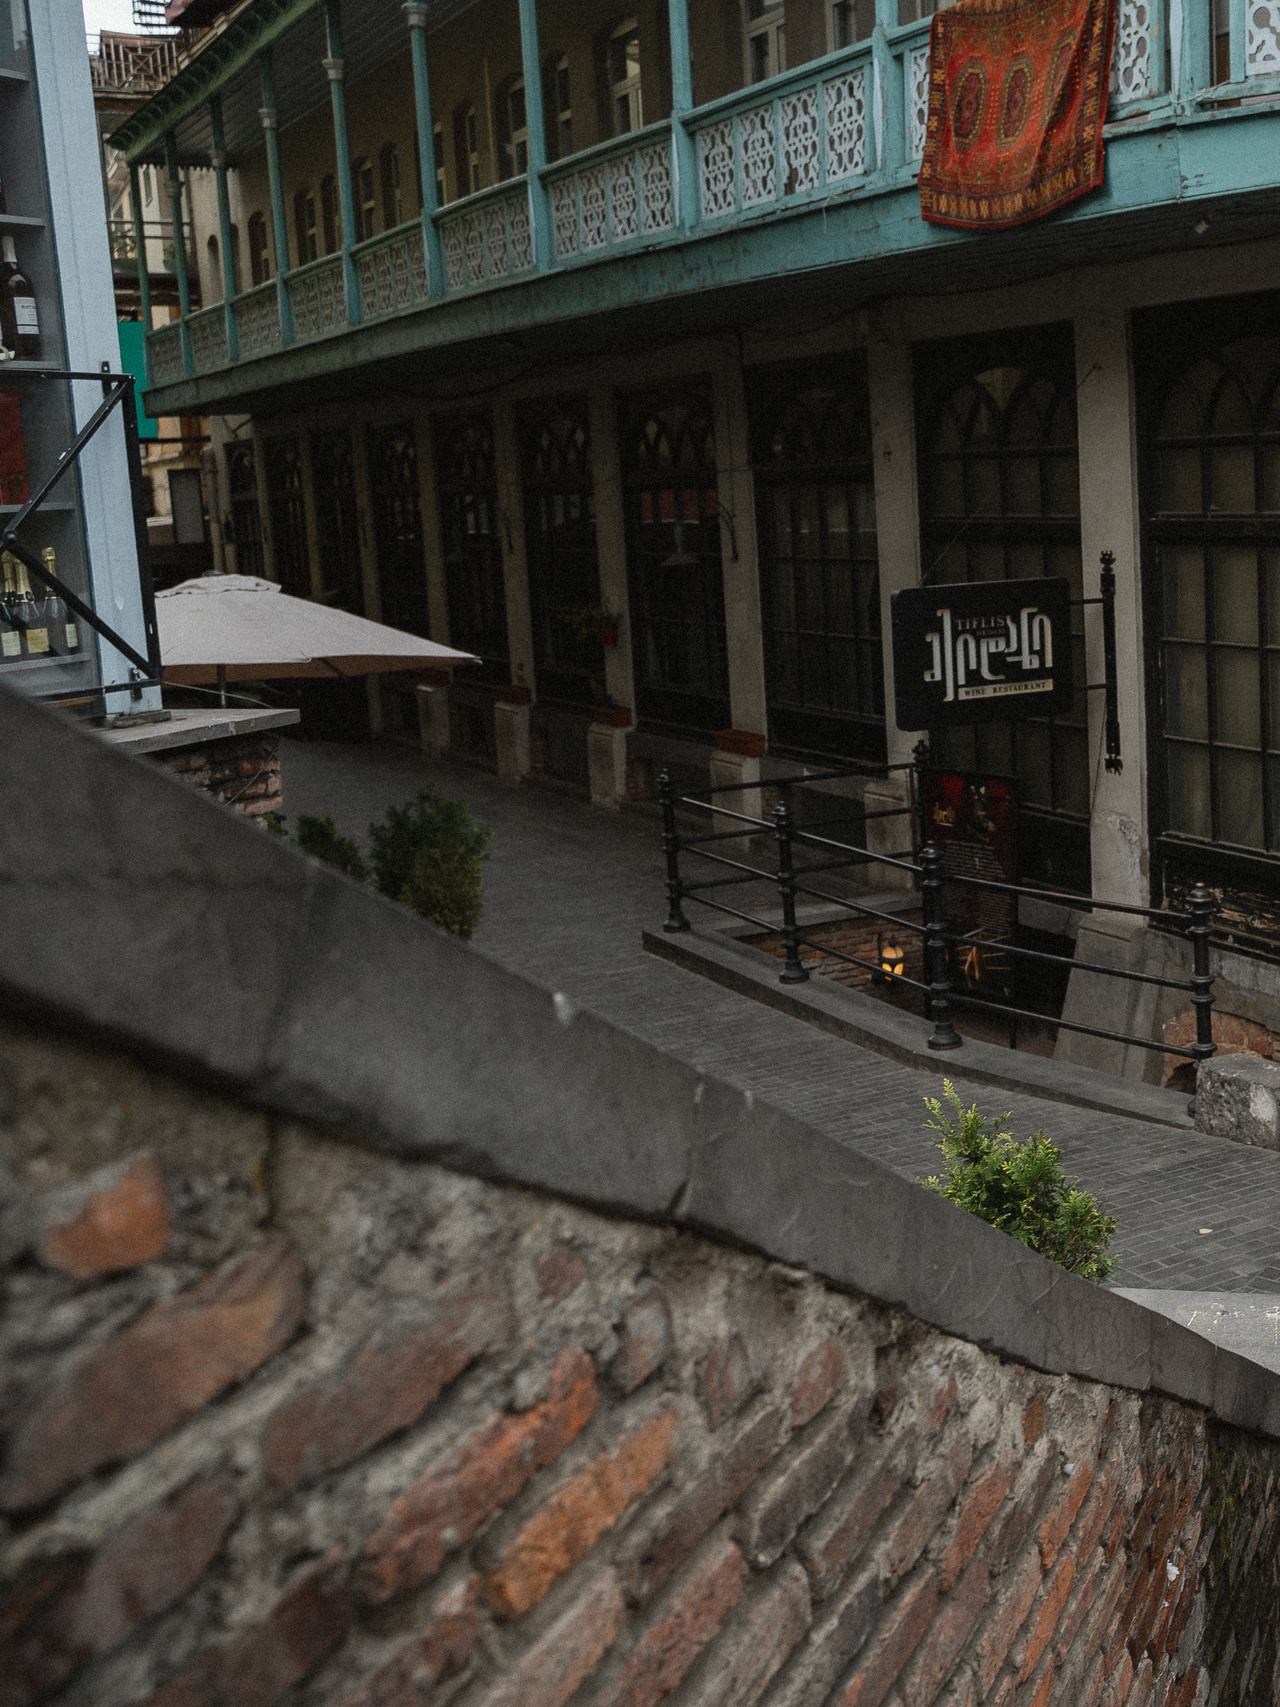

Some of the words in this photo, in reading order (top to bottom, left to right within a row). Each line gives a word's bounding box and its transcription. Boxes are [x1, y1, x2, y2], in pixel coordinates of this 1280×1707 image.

[956, 615, 1005, 631] TIFLIS
[964, 687, 987, 697] WINE
[993, 682, 1046, 695] RESTAURANT
